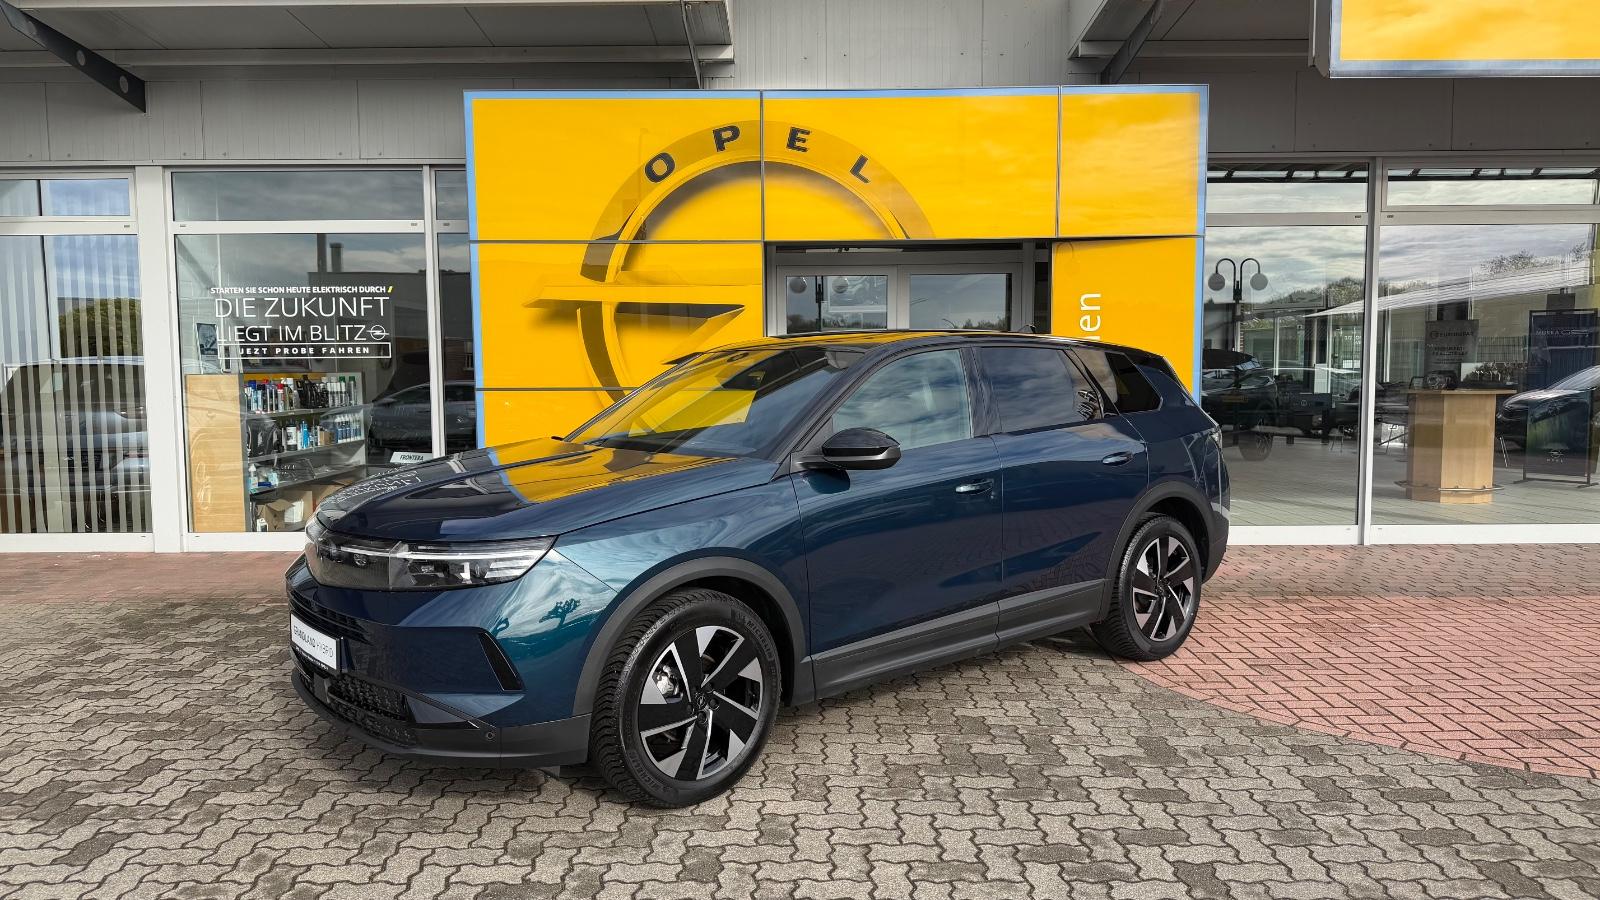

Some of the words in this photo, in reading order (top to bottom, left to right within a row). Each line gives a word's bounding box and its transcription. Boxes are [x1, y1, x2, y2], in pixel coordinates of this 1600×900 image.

[644, 125, 871, 183] OPEL
[210, 286, 244, 294] STARTEN
[245, 286, 257, 294] SIE
[257, 286, 285, 294] SCHON
[286, 286, 311, 294] HEUTE
[312, 286, 358, 294] ELEKTRISCH
[358, 285, 386, 293] DURCH
[215, 297, 257, 318] DIE
[264, 296, 390, 318] ZUKUNFT
[216, 325, 272, 342] LIEGT
[279, 325, 302, 341] IM
[310, 324, 367, 341] BLITZ
[275, 347, 315, 355] PROBE
[321, 346, 370, 354] FAHREN
